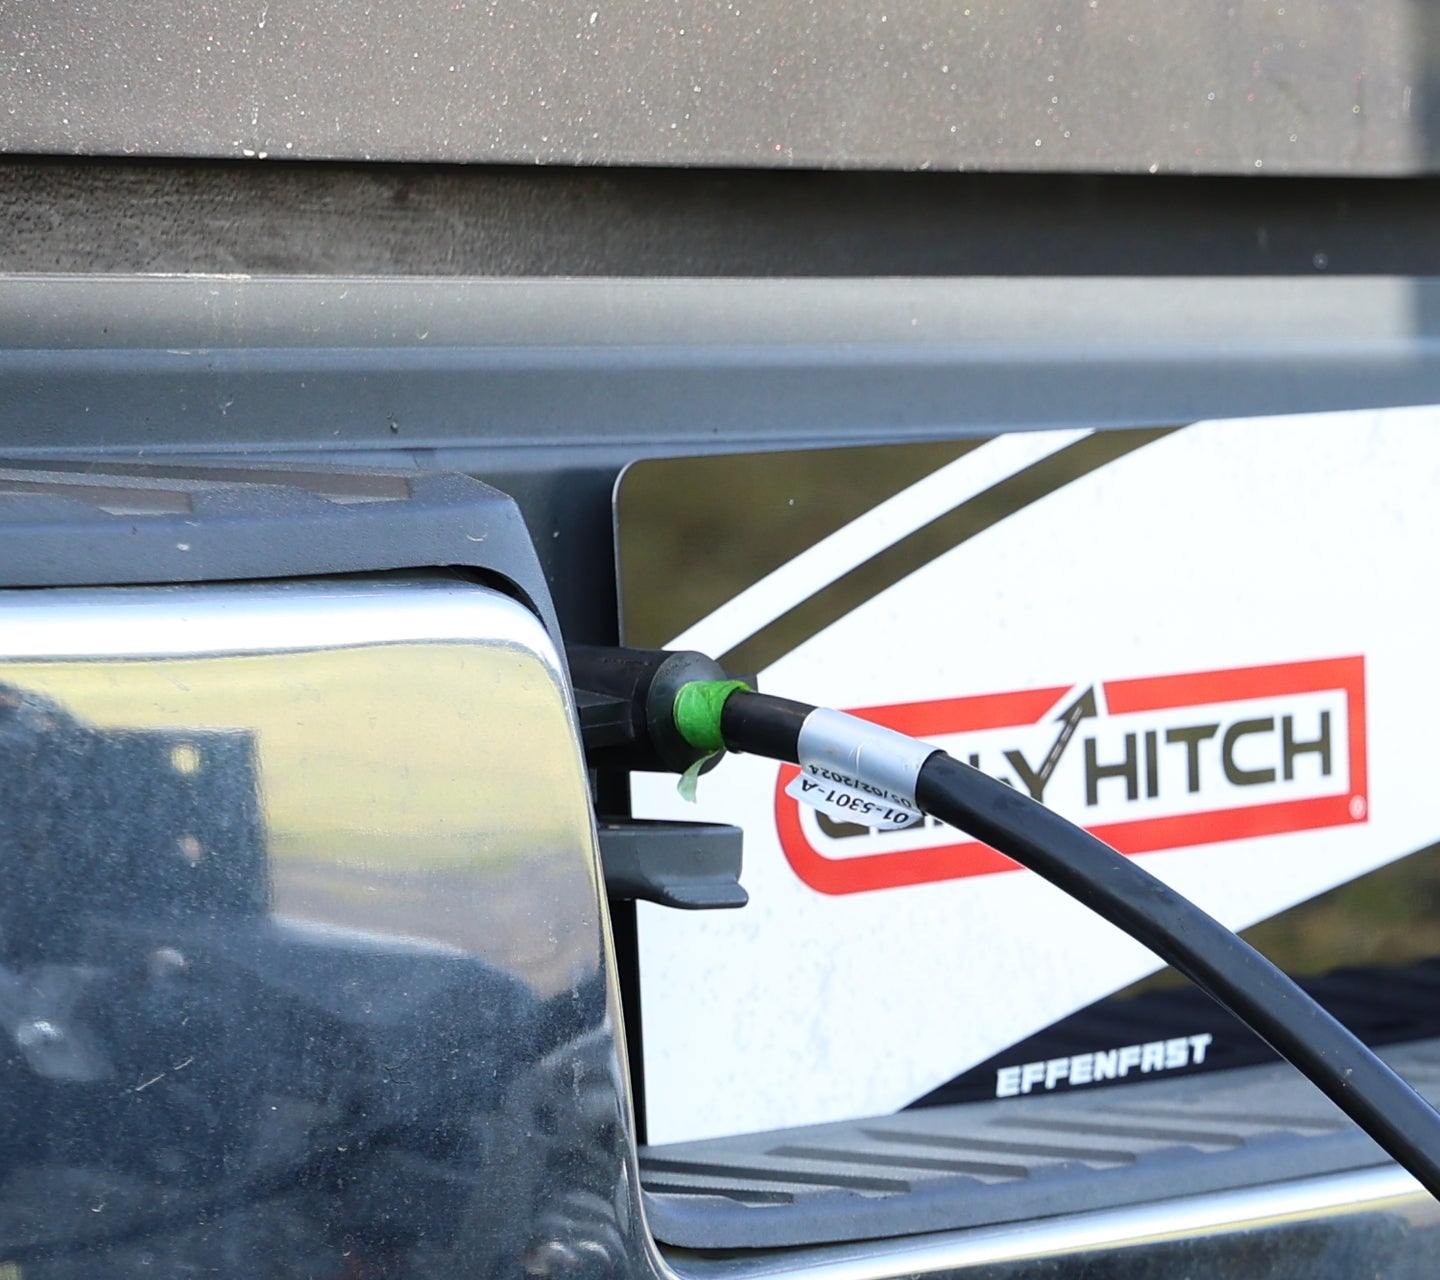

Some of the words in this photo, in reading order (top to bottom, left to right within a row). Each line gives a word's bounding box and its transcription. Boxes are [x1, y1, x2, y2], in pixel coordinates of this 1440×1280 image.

[809, 763, 912, 809] 05/02/2024
[1084, 710, 1333, 807] HITCH
[801, 779, 909, 824] 01-5301-A
[995, 1033, 1213, 1098] EFFENFAST
